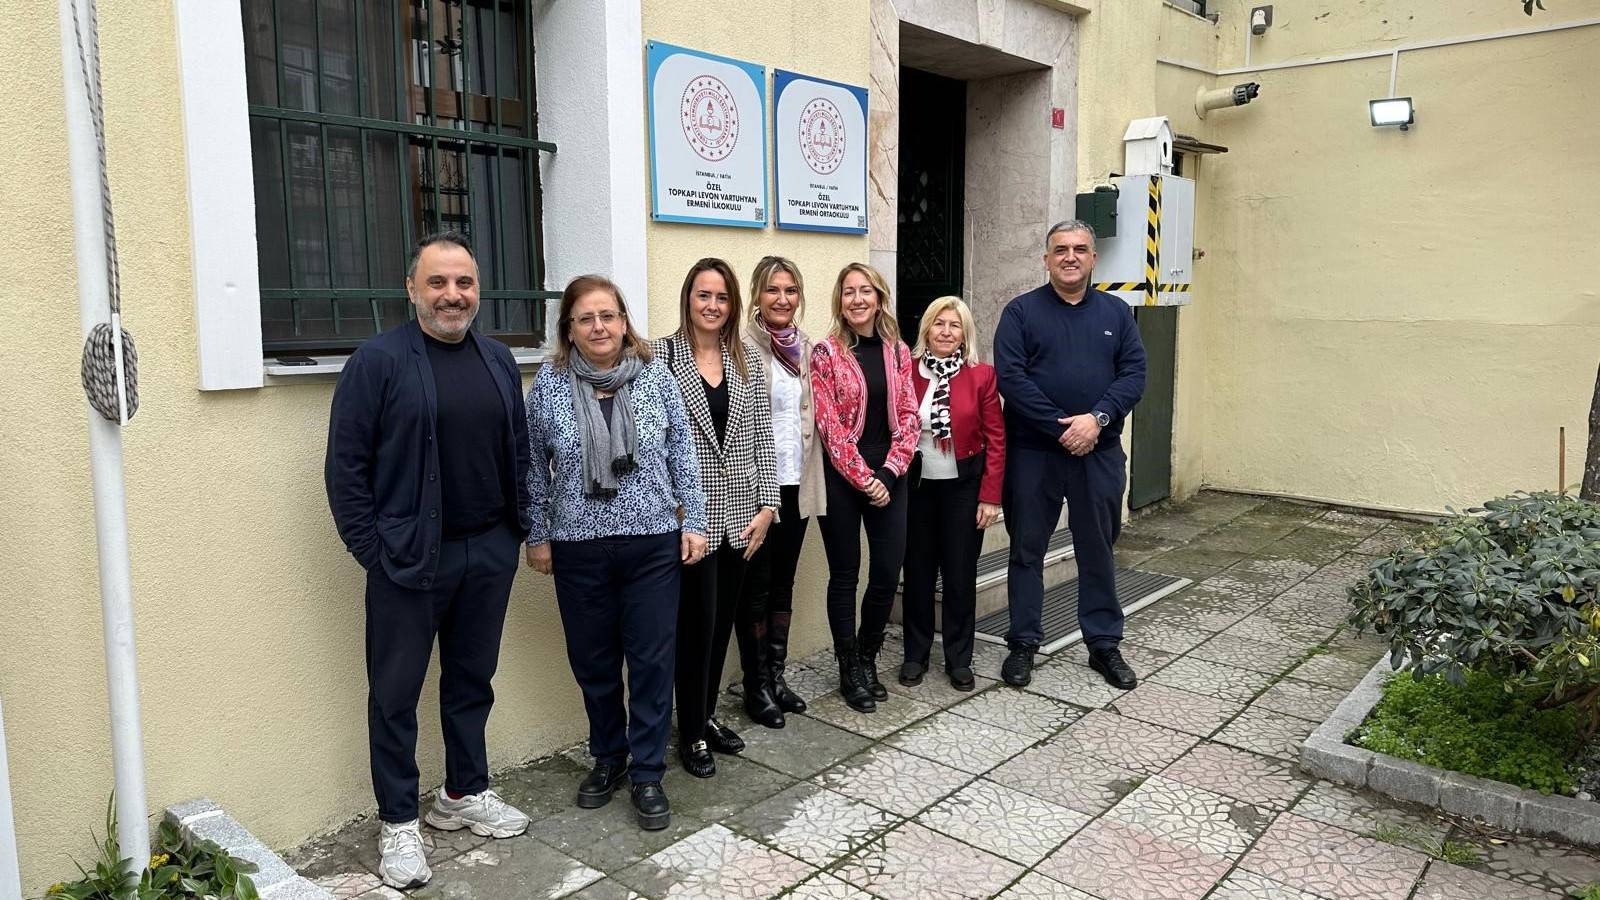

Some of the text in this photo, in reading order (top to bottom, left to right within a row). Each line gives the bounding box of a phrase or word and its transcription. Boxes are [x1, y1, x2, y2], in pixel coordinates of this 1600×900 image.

[695, 169, 716, 179] İSTANBUL
[706, 181, 722, 191] ÖZEL
[668, 188, 757, 204] TOPKAPI LEVON VARTUHYAN
[818, 192, 830, 201] ÖZEL
[686, 199, 742, 211] ERMENİ İLKOKULU
[788, 199, 811, 208] TOPKAPI
[829, 203, 859, 211] VARTUHYAN
[799, 208, 849, 219] ERMENİ ORTAOKULU
